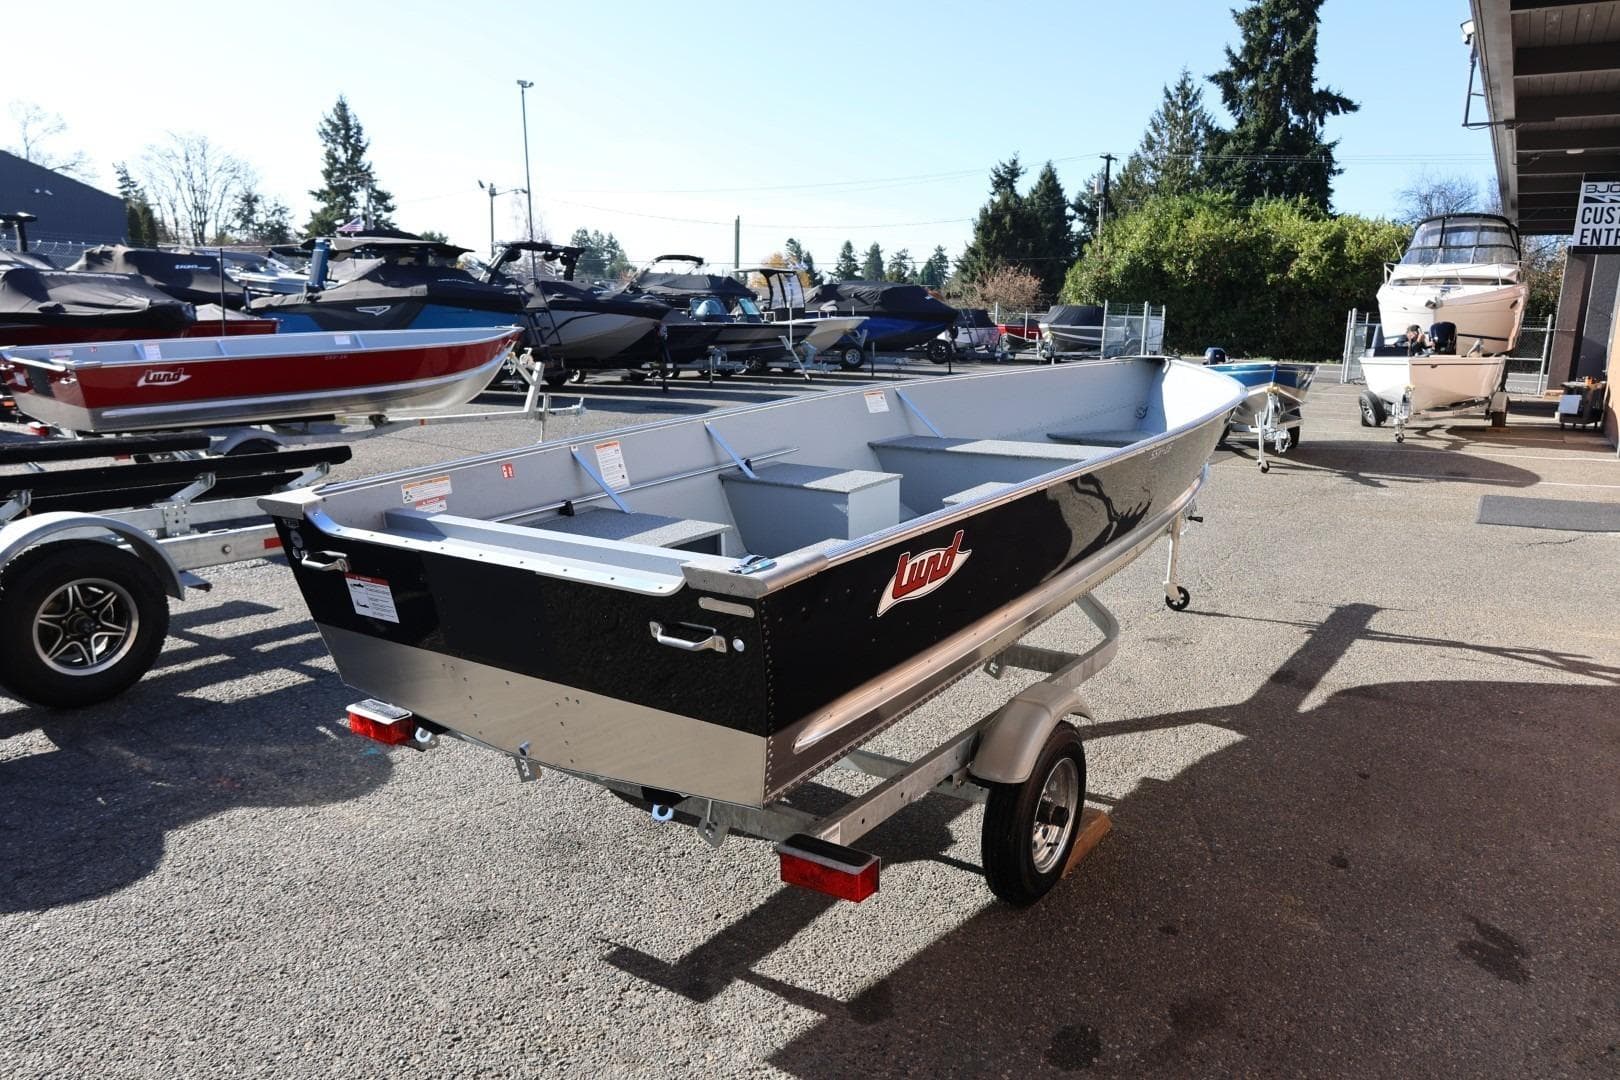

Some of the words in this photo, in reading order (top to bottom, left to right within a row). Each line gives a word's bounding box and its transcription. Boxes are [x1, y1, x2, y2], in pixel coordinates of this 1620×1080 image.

[1581, 206, 1620, 224] CUS
[144, 367, 184, 384] Lund
[892, 530, 964, 600] Lund
